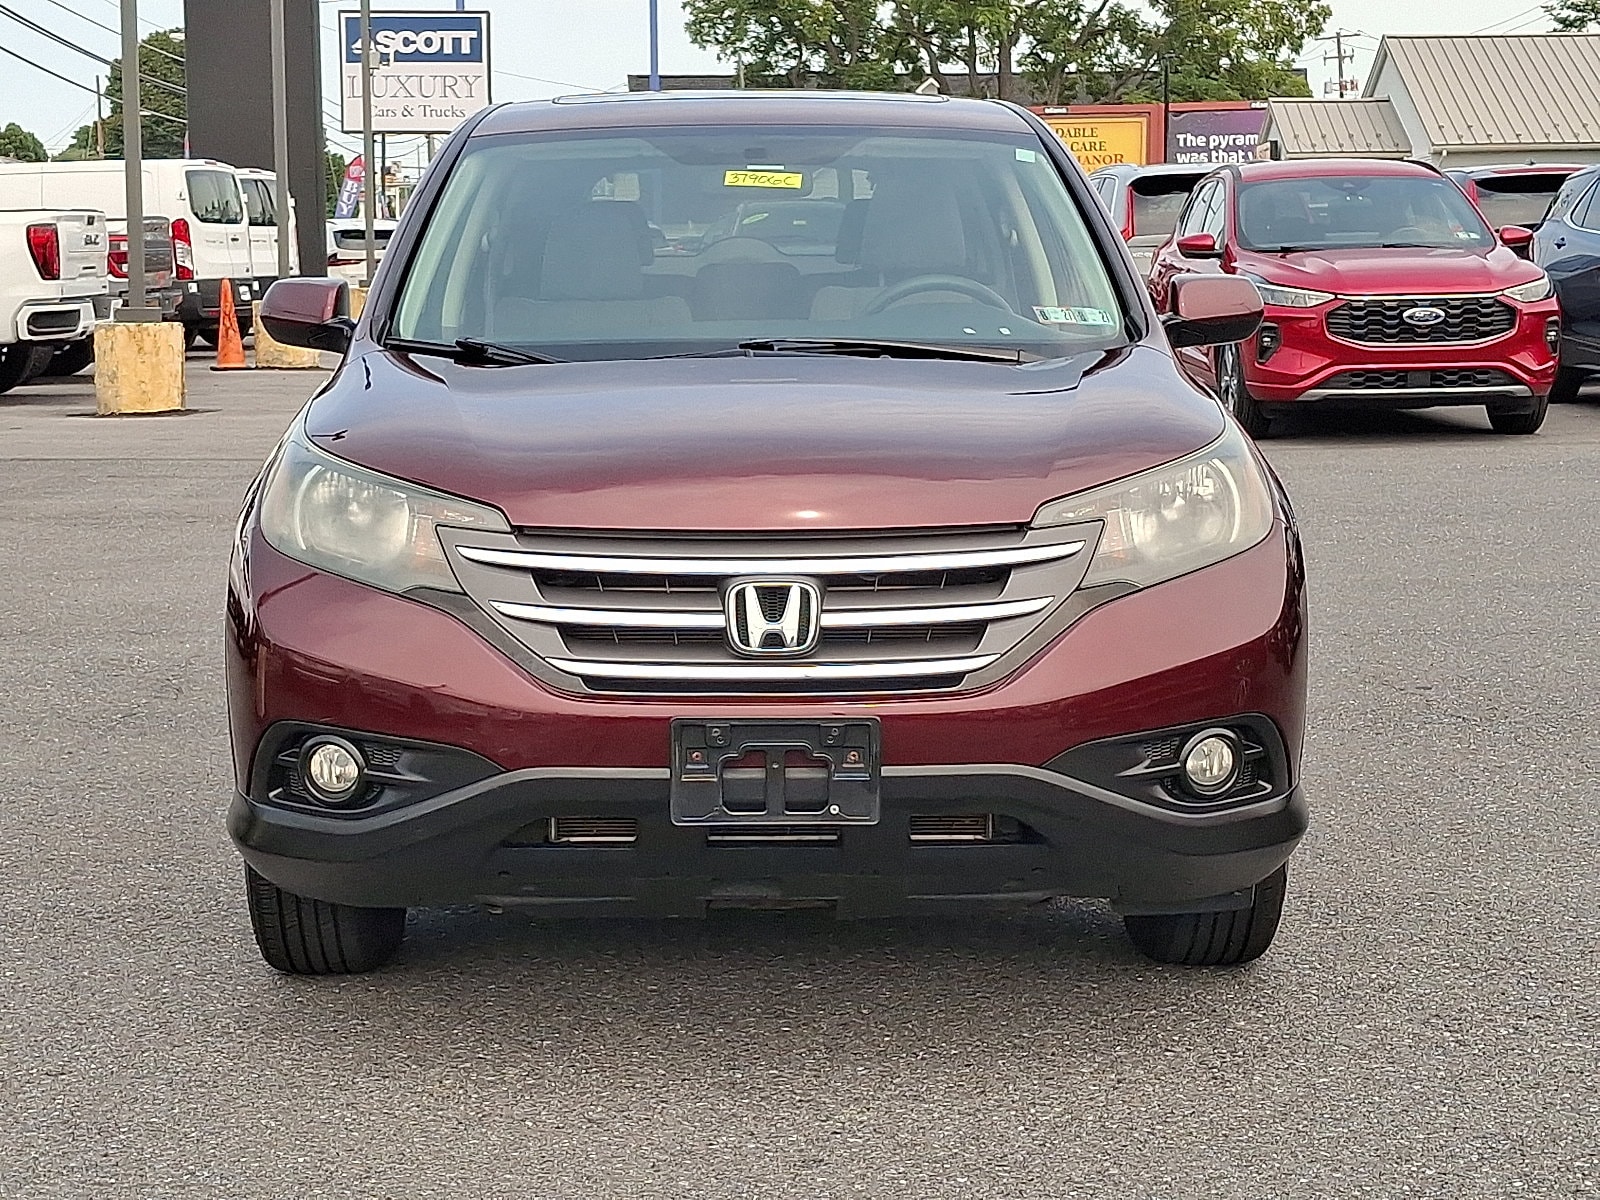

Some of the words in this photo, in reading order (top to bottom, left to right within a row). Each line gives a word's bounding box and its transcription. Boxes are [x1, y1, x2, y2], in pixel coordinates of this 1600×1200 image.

[375, 29, 478, 54] SCOTT
[346, 75, 482, 99] LUXURY
[401, 105, 415, 118] &
[418, 104, 466, 118] Trucks
[1070, 141, 1107, 152] CARE
[1176, 132, 1207, 148] The
[1208, 134, 1259, 150] pyram
[1175, 151, 1209, 164] was
[1211, 149, 1245, 164] that
